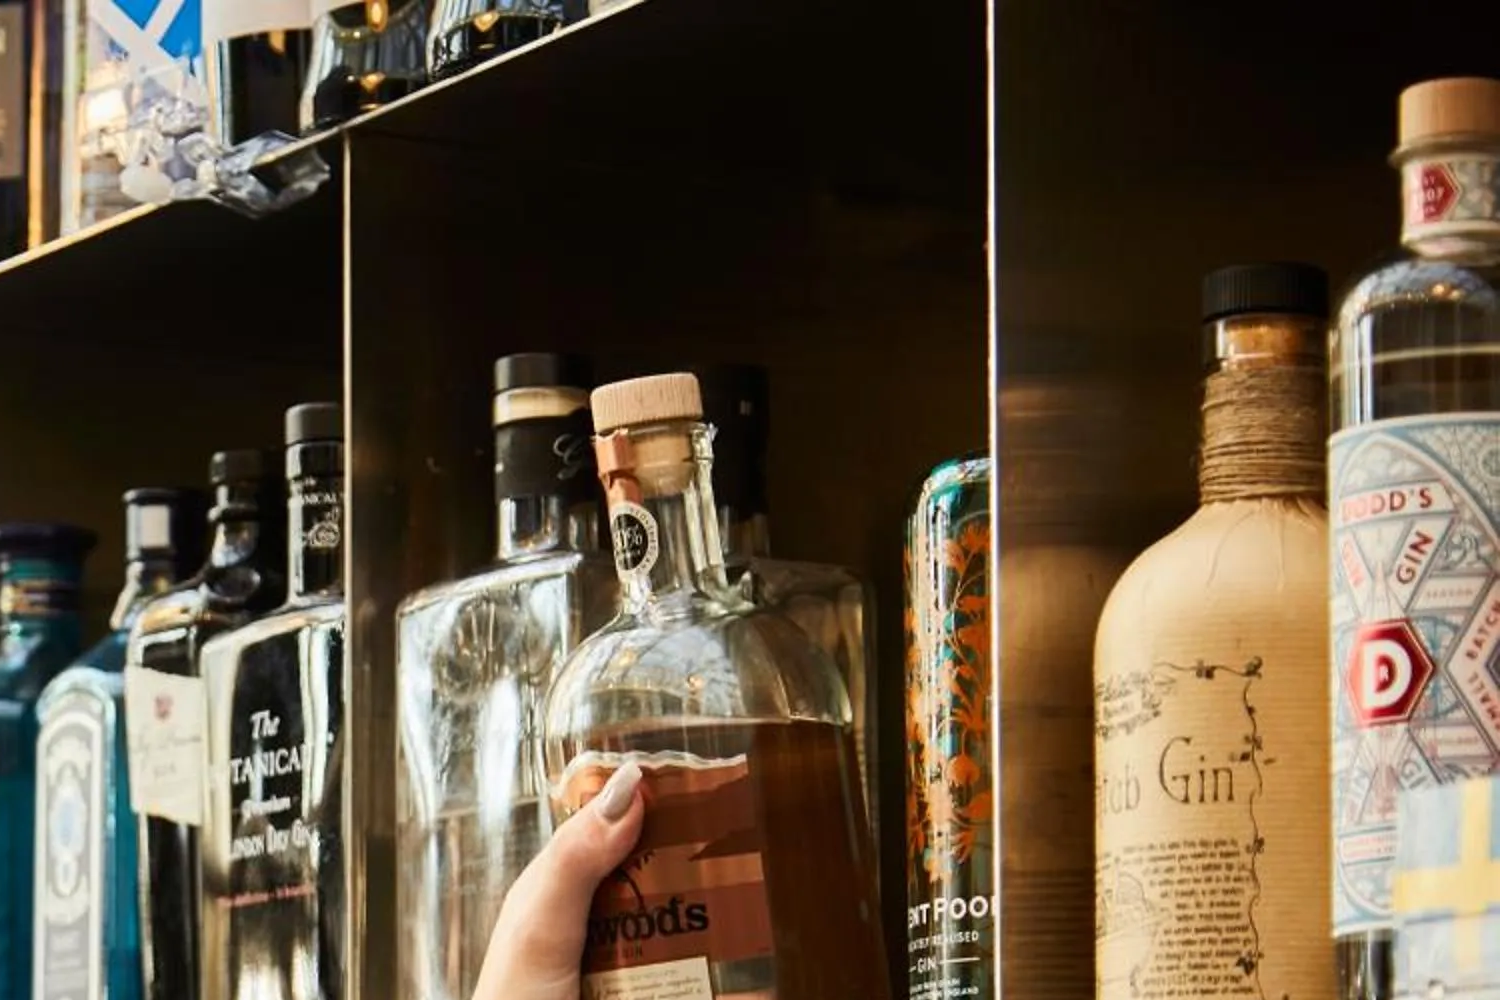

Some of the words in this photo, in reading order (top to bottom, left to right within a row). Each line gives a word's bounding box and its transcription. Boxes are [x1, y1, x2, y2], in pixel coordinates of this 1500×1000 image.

[1396, 530, 1434, 585] GIN
[250, 709, 280, 740] The
[1159, 736, 1234, 804] Gin
